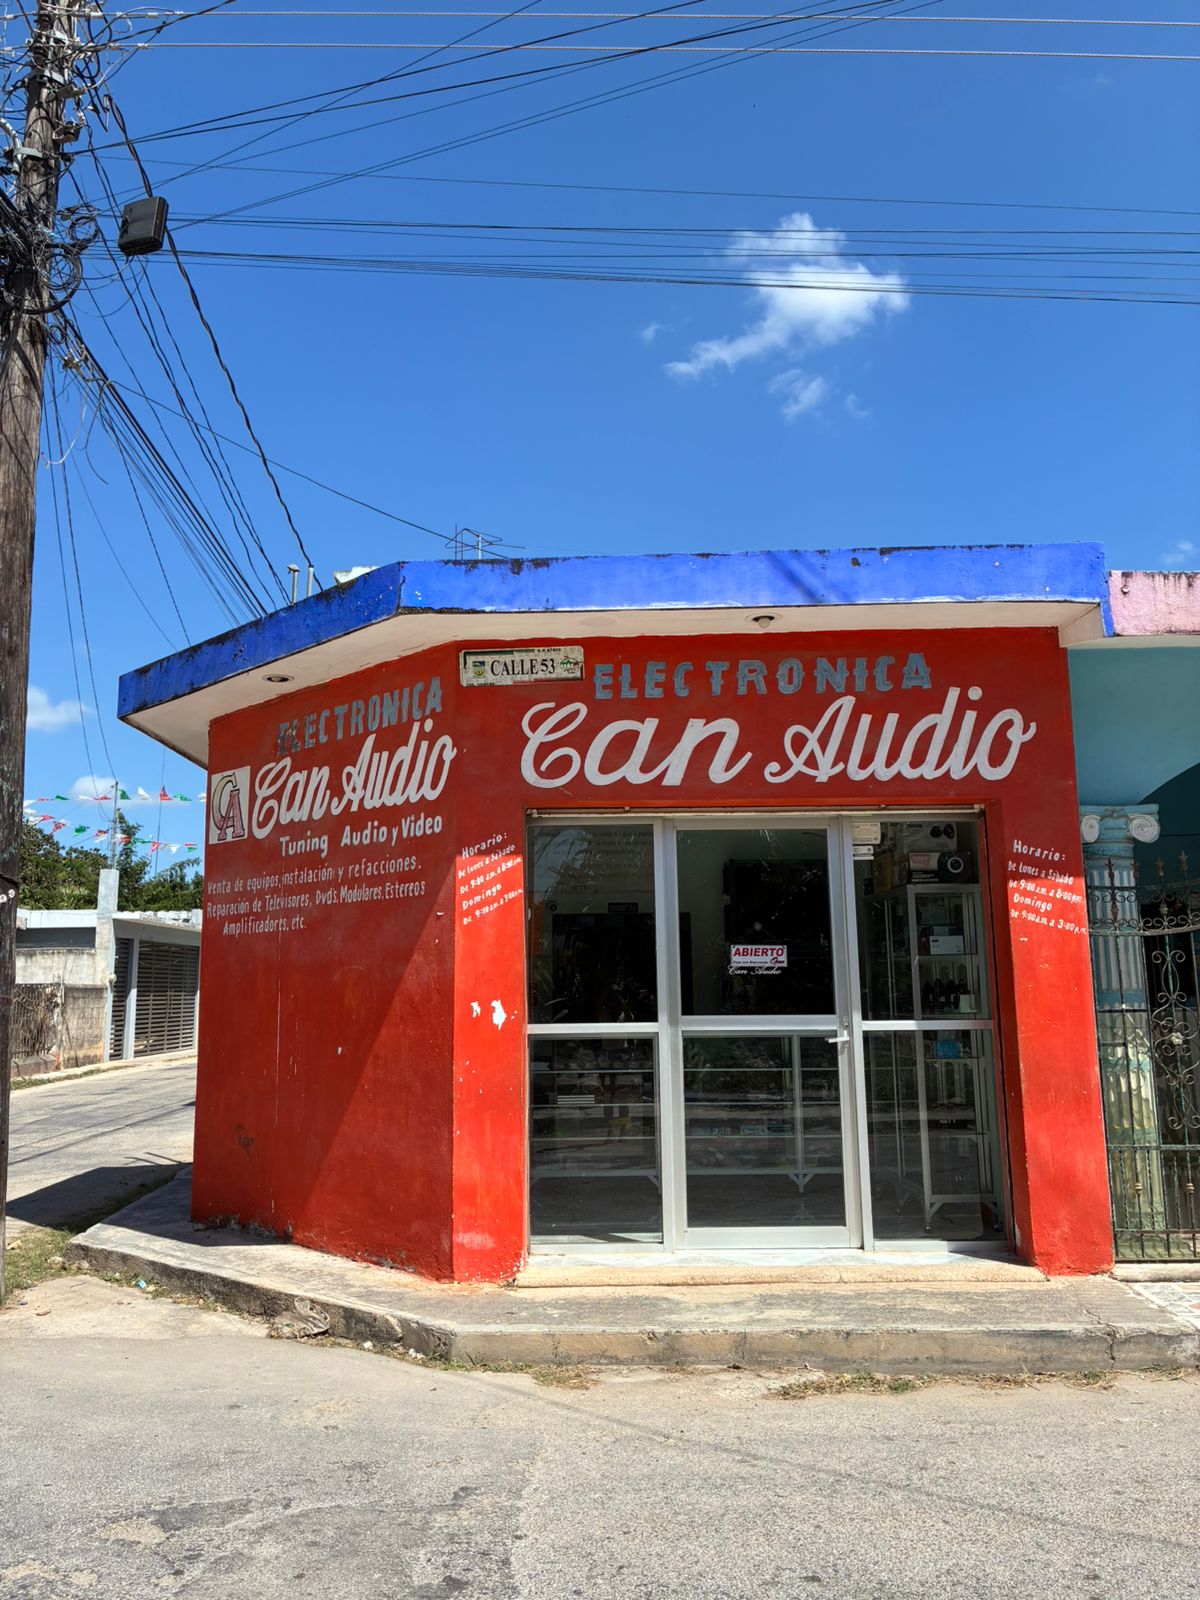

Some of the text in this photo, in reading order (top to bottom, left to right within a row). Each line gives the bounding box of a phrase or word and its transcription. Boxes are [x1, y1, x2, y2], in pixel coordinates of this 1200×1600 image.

[491, 658, 555, 676] CALLE 53
[593, 652, 932, 699] ELECTRONICA
[277, 676, 443, 755] ELECTRONICA
[520, 686, 1037, 788] Can Audio
[252, 718, 457, 839] Can Audio
[279, 815, 442, 859] Tuning Audio y Video
[462, 832, 507, 859] Horario:
[1013, 839, 1066, 861] Horario:
[207, 879, 231, 895] Venta
[234, 876, 243, 892] de
[338, 866, 344, 883] y
[348, 854, 422, 879] refacciones.
[1008, 860, 1016, 871] De
[1019, 862, 1039, 876] Lunes
[1041, 870, 1046, 878] a
[252, 897, 262, 913] de
[385, 880, 426, 900] Estereos
[462, 883, 502, 911] Domingo
[1013, 893, 1052, 912] Domingo
[292, 914, 307, 930] etc.
[733, 948, 784, 956] ABIERTO
